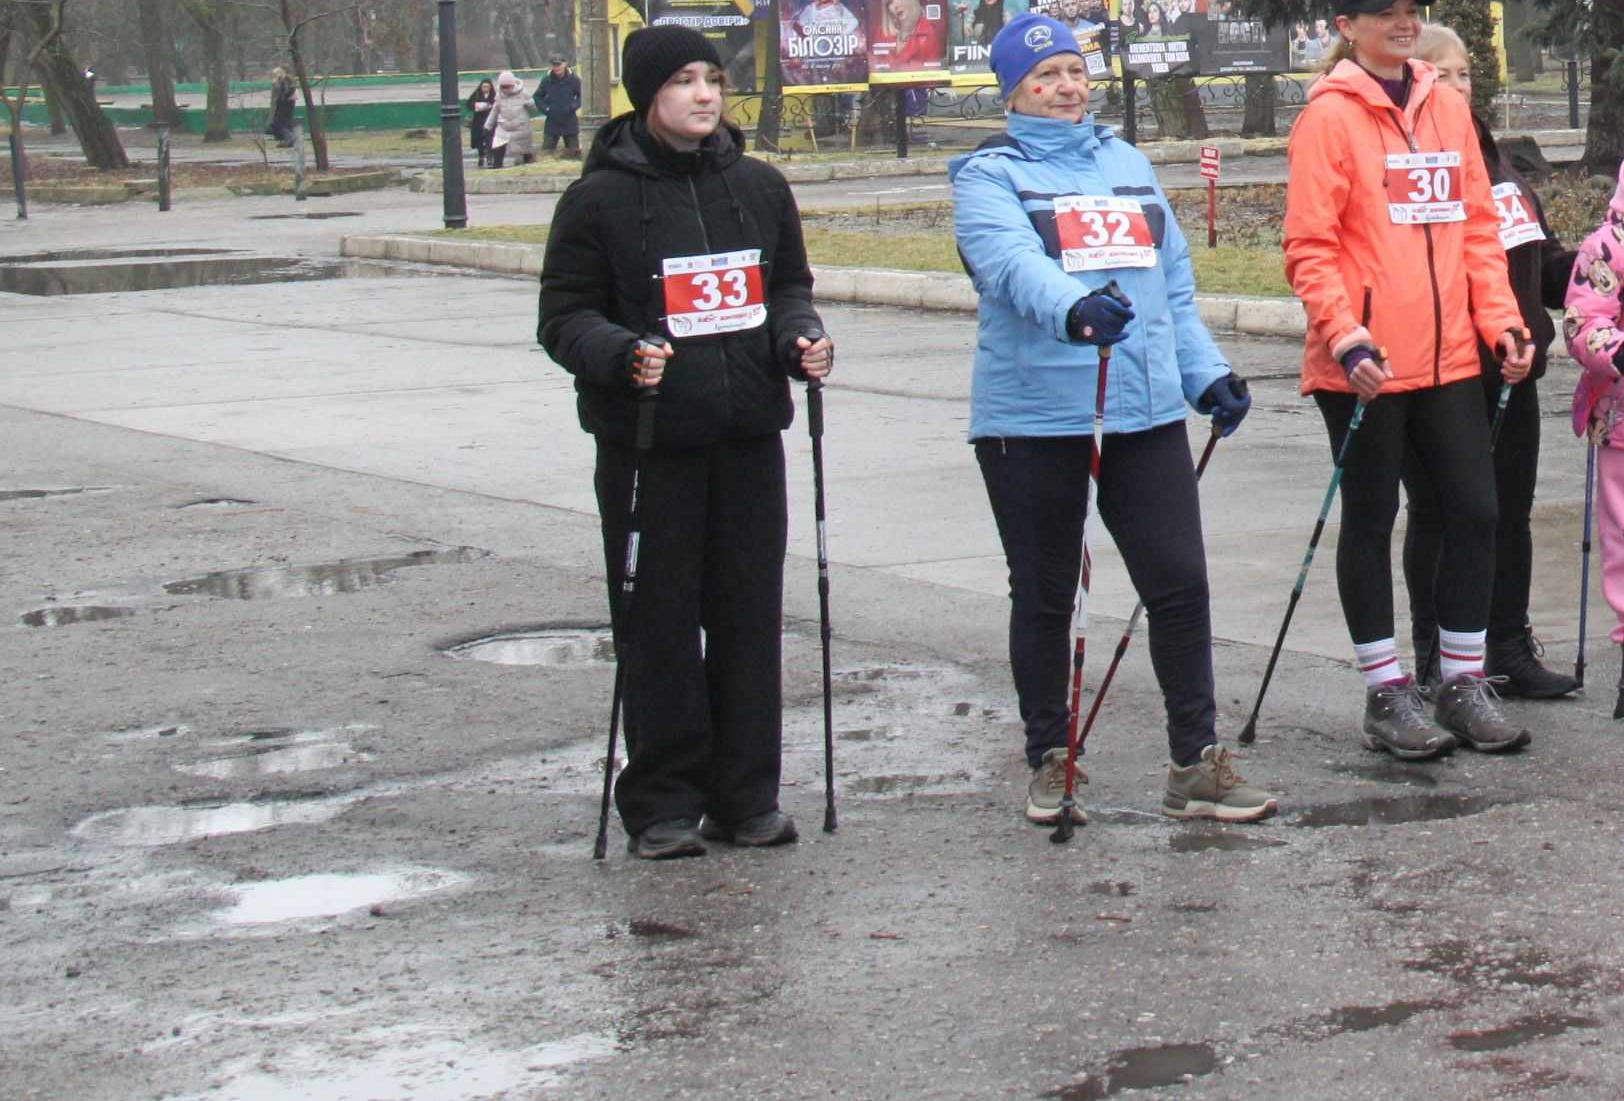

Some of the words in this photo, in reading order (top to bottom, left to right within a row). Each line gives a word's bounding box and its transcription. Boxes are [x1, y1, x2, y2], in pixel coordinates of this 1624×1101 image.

[788, 35, 859, 57] БІЛОЗІР
[803, 25, 843, 35] ОКСАНА
[1407, 168, 1450, 203] 30
[1081, 211, 1136, 246] 32
[1494, 194, 1530, 230] 34
[691, 269, 748, 310] 33
